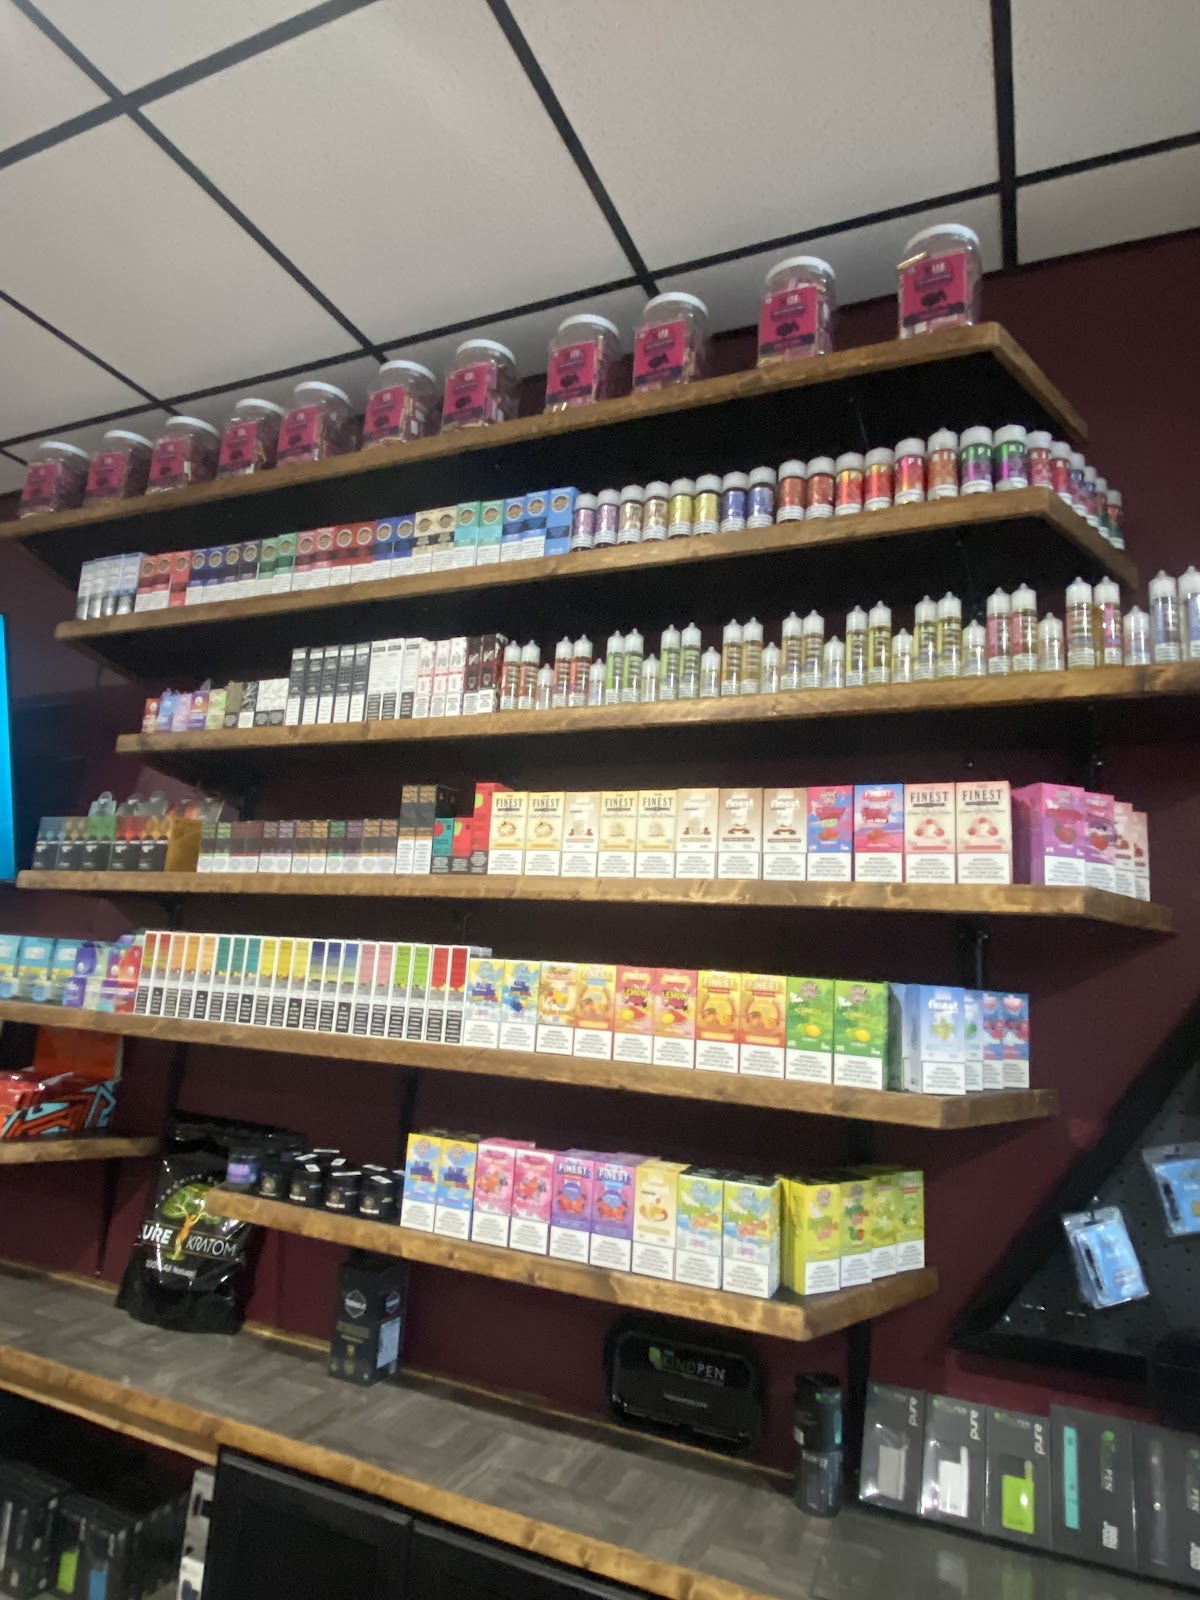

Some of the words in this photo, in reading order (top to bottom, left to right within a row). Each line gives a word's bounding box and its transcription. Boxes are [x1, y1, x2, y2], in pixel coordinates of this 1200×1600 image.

[910, 791, 948, 802] FINEST
[963, 789, 1003, 801] FINEST
[496, 798, 523, 808] FINEST
[532, 798, 560, 808] FINEST
[604, 798, 634, 807] FINEST
[642, 797, 673, 807] FINEST
[558, 1162, 588, 1175] FINEST
[598, 1166, 630, 1183] FINEST
[138, 1224, 173, 1245] URE
[185, 1234, 238, 1258] KRATOM
[908, 1396, 919, 1428] pure
[969, 1408, 981, 1441] pure
[1033, 1422, 1046, 1456] pure
